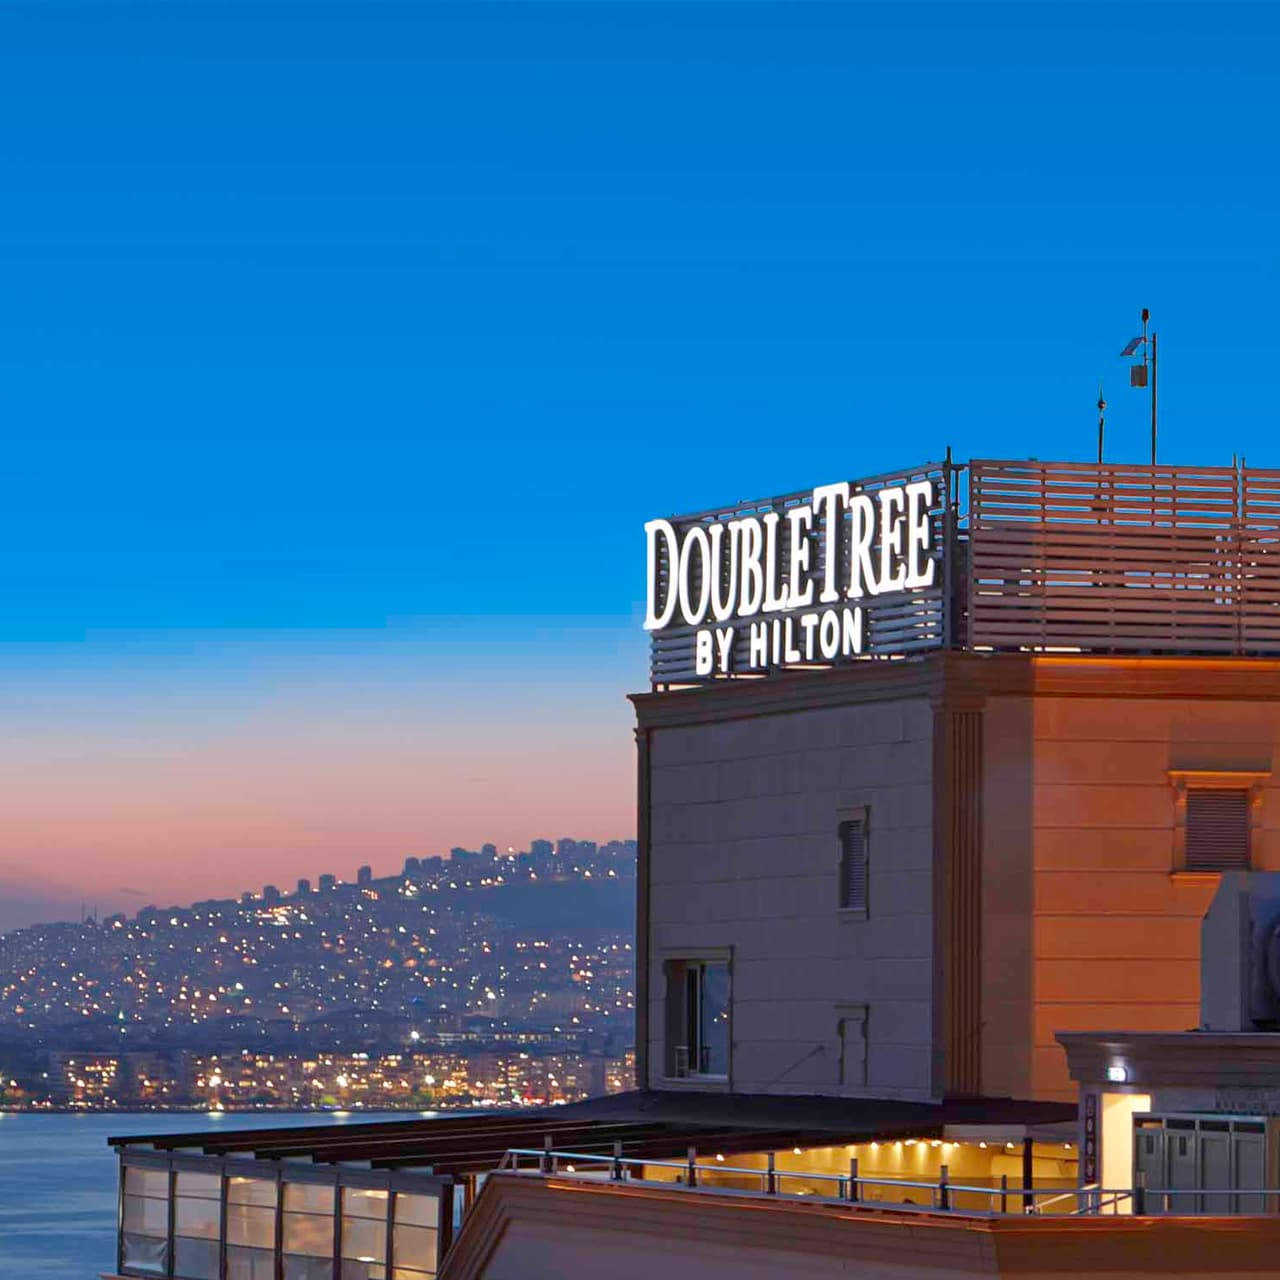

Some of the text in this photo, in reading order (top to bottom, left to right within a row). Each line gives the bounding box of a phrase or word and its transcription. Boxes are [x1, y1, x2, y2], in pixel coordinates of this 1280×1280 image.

[643, 480, 935, 630] DOUBLETREE
[695, 606, 862, 675] BY HILTON
